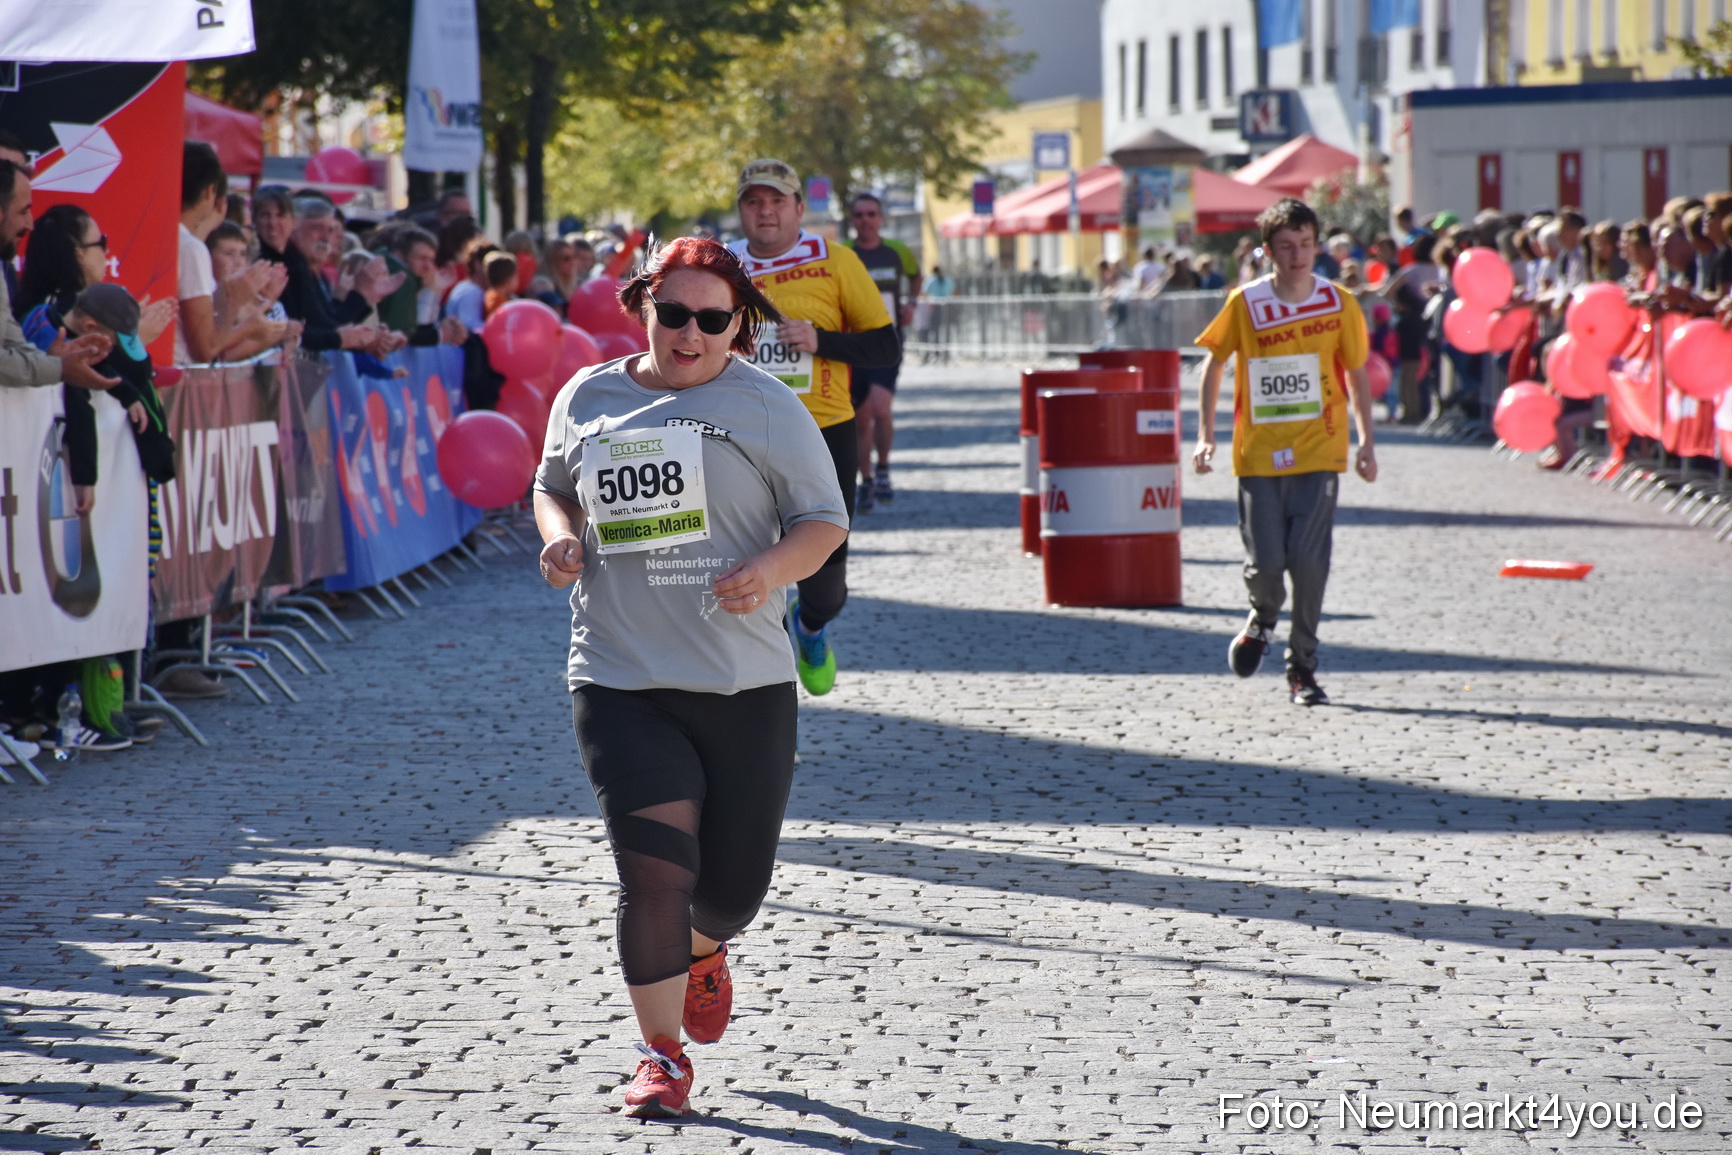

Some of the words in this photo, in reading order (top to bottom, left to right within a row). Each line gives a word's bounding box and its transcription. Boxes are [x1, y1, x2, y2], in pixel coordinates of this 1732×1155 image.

[775, 267, 832, 284] BÖGL
[1257, 329, 1296, 348] MAX
[1261, 373, 1310, 396] 5095
[610, 439, 664, 457] BOCK
[597, 460, 685, 504] 5098
[610, 508, 631, 516] PARTL
[632, 503, 669, 514] Neumarkt
[600, 514, 702, 541] Veronica-Maria
[646, 557, 723, 570] Neumarkter
[648, 572, 711, 586] Stadtlauf
